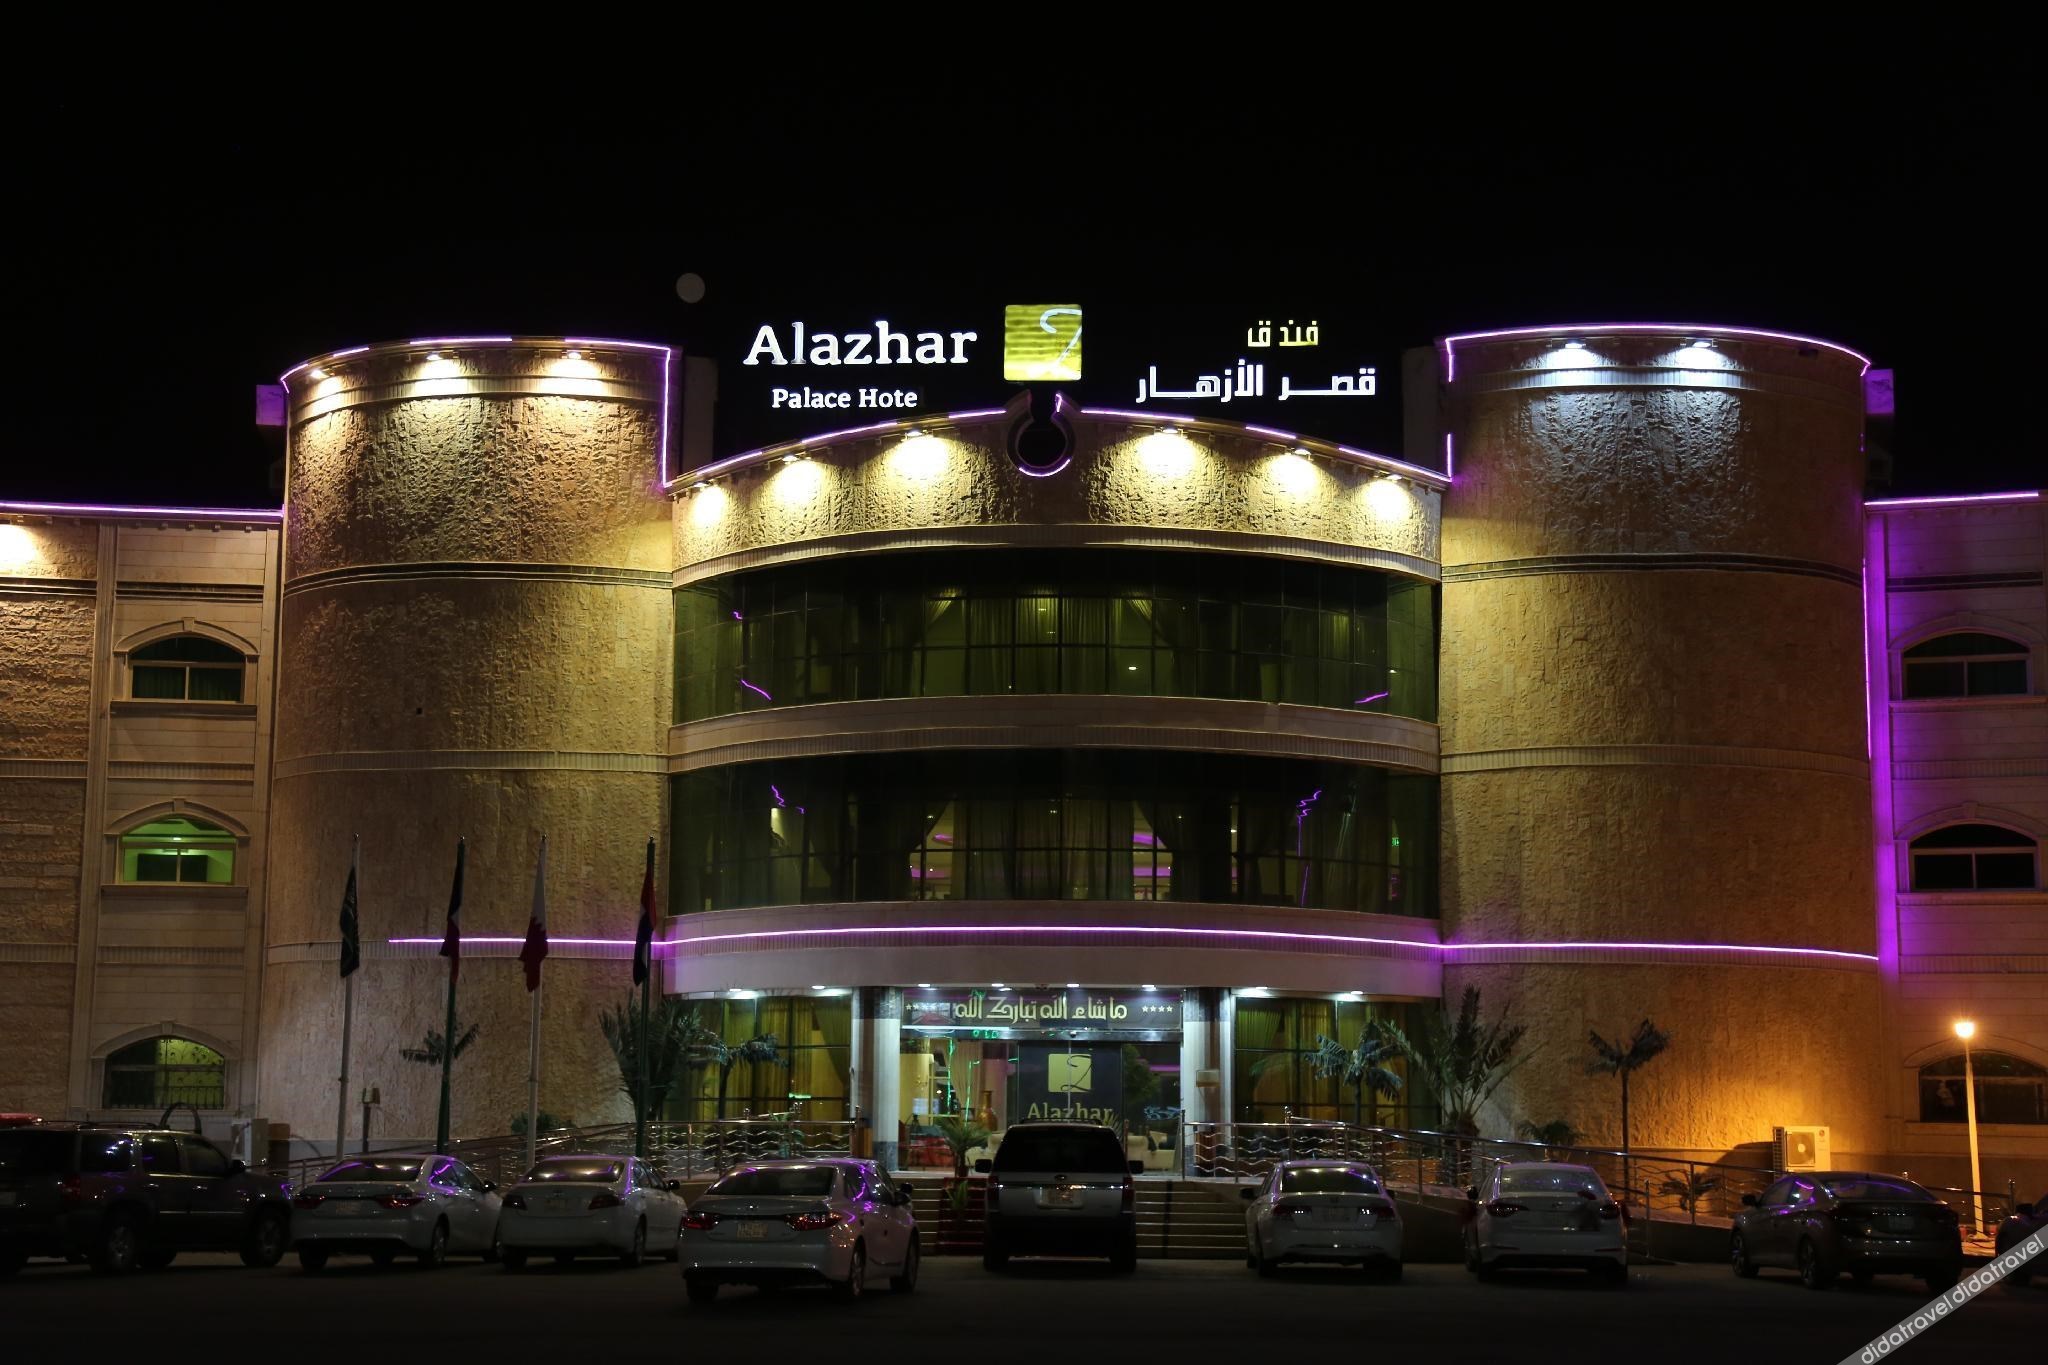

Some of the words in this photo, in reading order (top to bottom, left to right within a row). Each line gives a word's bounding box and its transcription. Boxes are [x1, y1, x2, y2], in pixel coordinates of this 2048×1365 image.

[742, 320, 978, 366] Alazhar
[1135, 358, 1264, 403] الأزهار
[1278, 367, 1376, 401] قصر
[771, 386, 851, 408] Palace
[985, 996, 1037, 1024] تبارك
[1039, 993, 1068, 1020] الله
[1026, 1101, 1114, 1126] Alazhar
